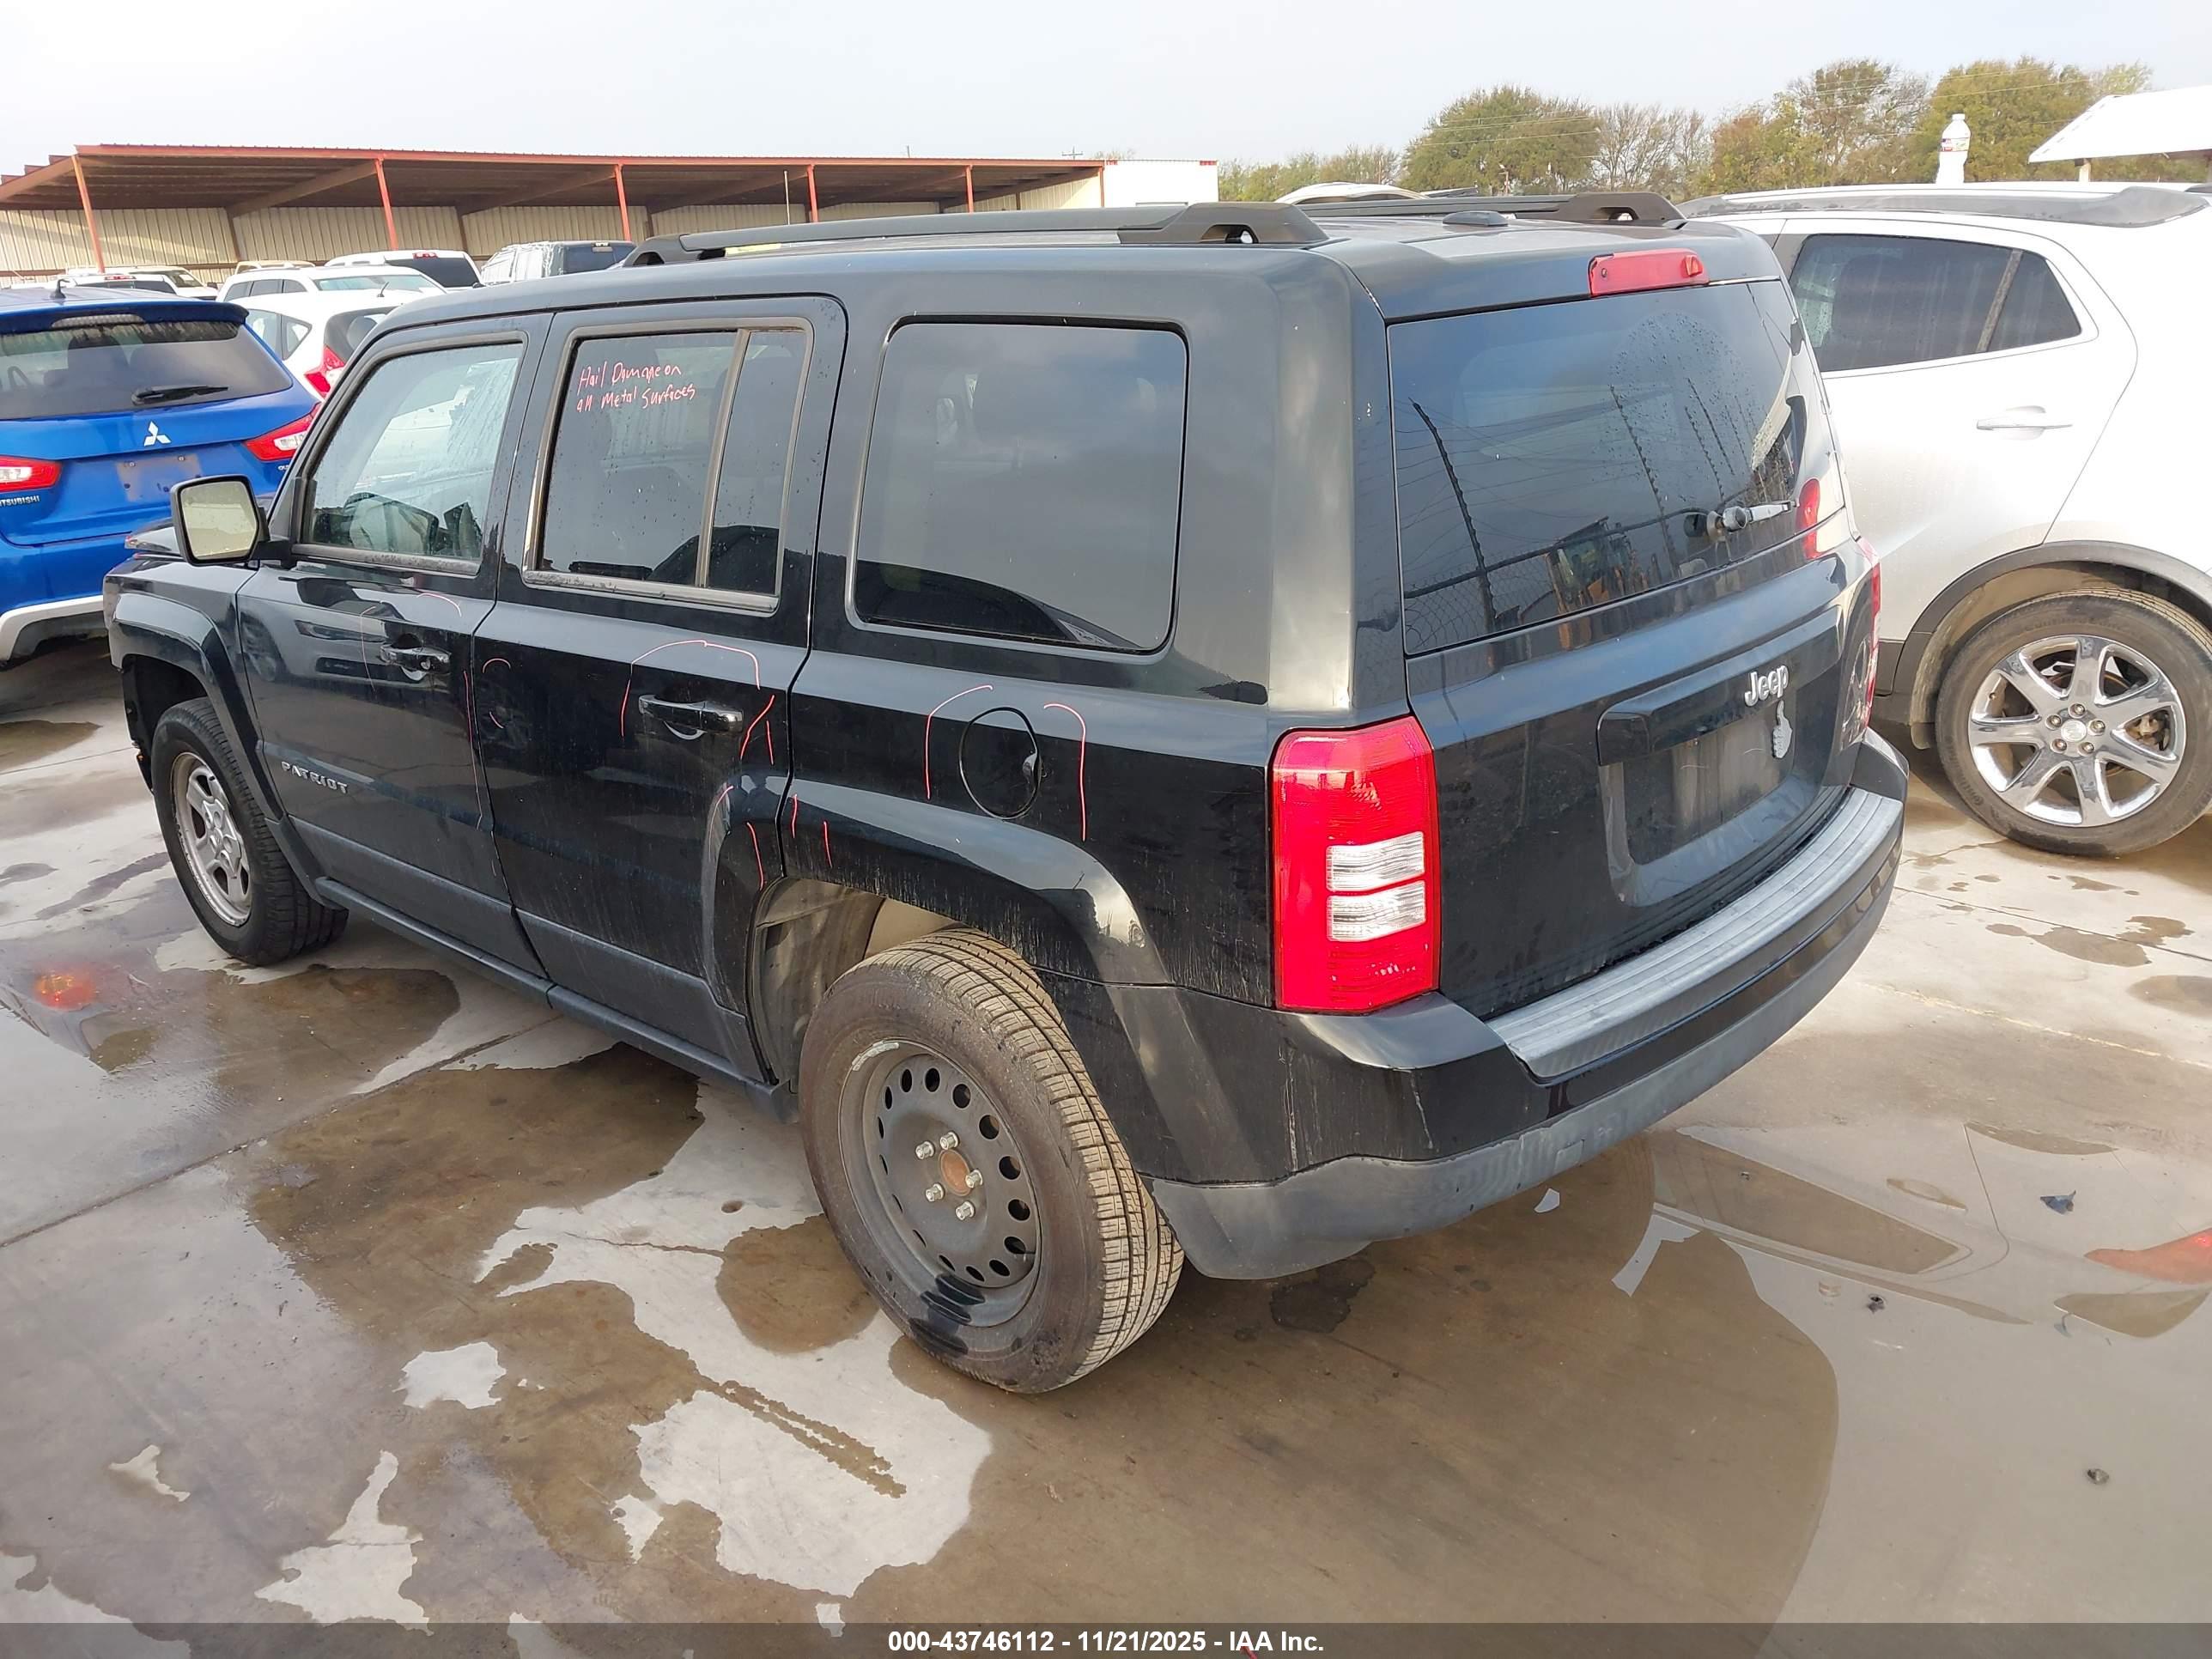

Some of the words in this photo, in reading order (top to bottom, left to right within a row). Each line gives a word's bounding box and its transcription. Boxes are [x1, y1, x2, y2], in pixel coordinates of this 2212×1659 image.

[577, 361, 607, 396] Hail
[664, 364, 682, 376] on
[1744, 665, 1790, 707] Jeep
[281, 761, 348, 794] PATRIOT
